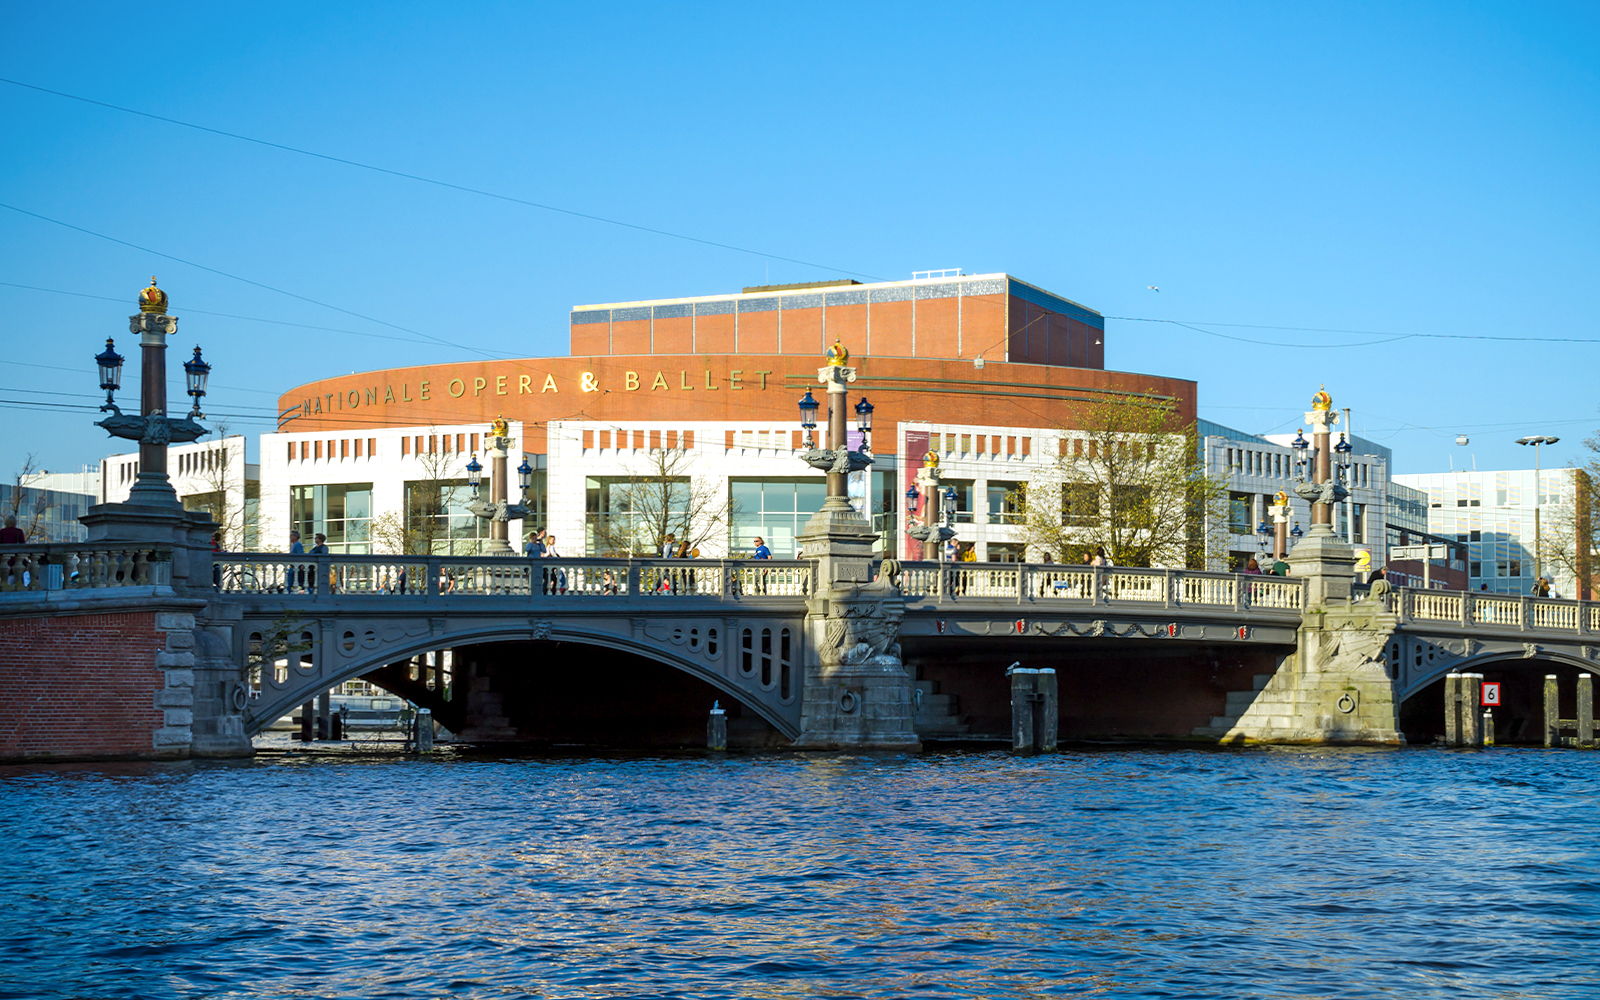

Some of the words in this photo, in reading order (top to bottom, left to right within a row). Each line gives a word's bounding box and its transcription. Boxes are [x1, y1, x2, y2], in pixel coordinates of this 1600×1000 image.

[303, 381, 431, 417] NATIONALE
[448, 373, 560, 398] OPERA
[581, 371, 600, 393] &
[625, 370, 772, 391] BALLET
[1487, 687, 1495, 701] 6
